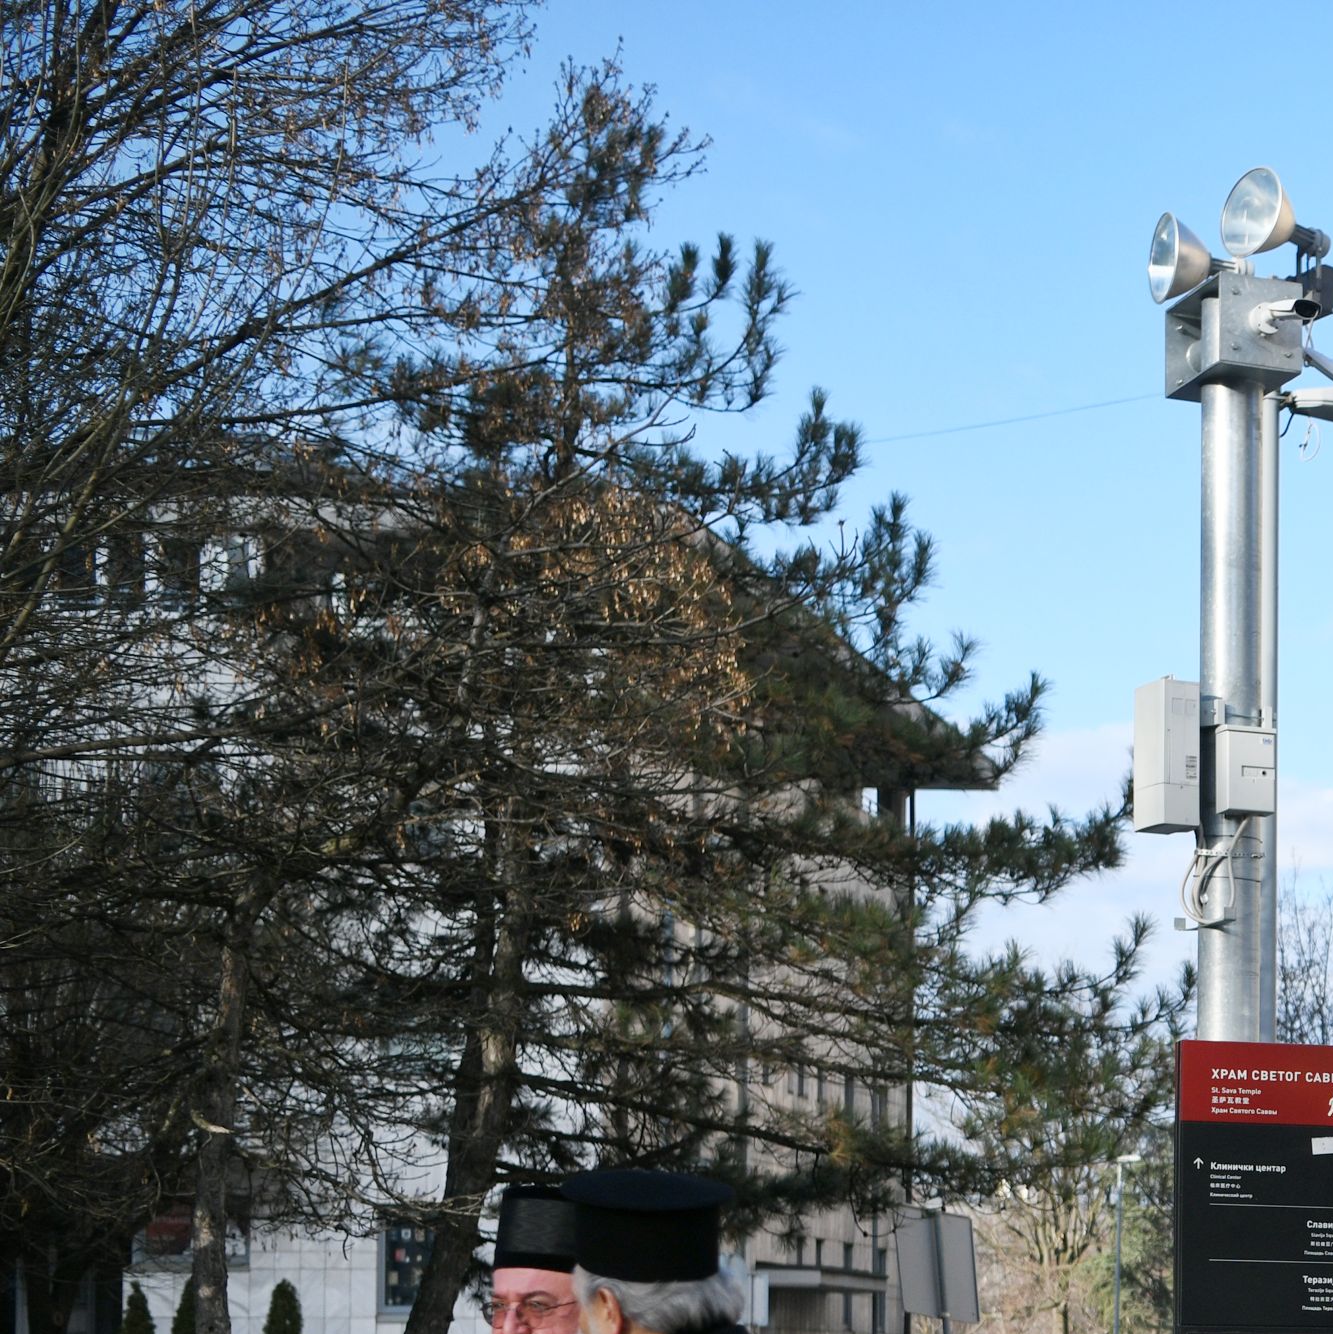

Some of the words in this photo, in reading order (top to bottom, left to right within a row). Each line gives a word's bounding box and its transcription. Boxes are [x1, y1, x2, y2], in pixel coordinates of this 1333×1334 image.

[1211, 1068, 1248, 1080] ХРАМ
[1251, 1070, 1302, 1082] СВЕТОГ
[1238, 1087, 1262, 1096] Temple
[1211, 1106, 1228, 1115] Храм
[1210, 1161, 1254, 1171] Клинички
[1255, 1164, 1287, 1174] центар
